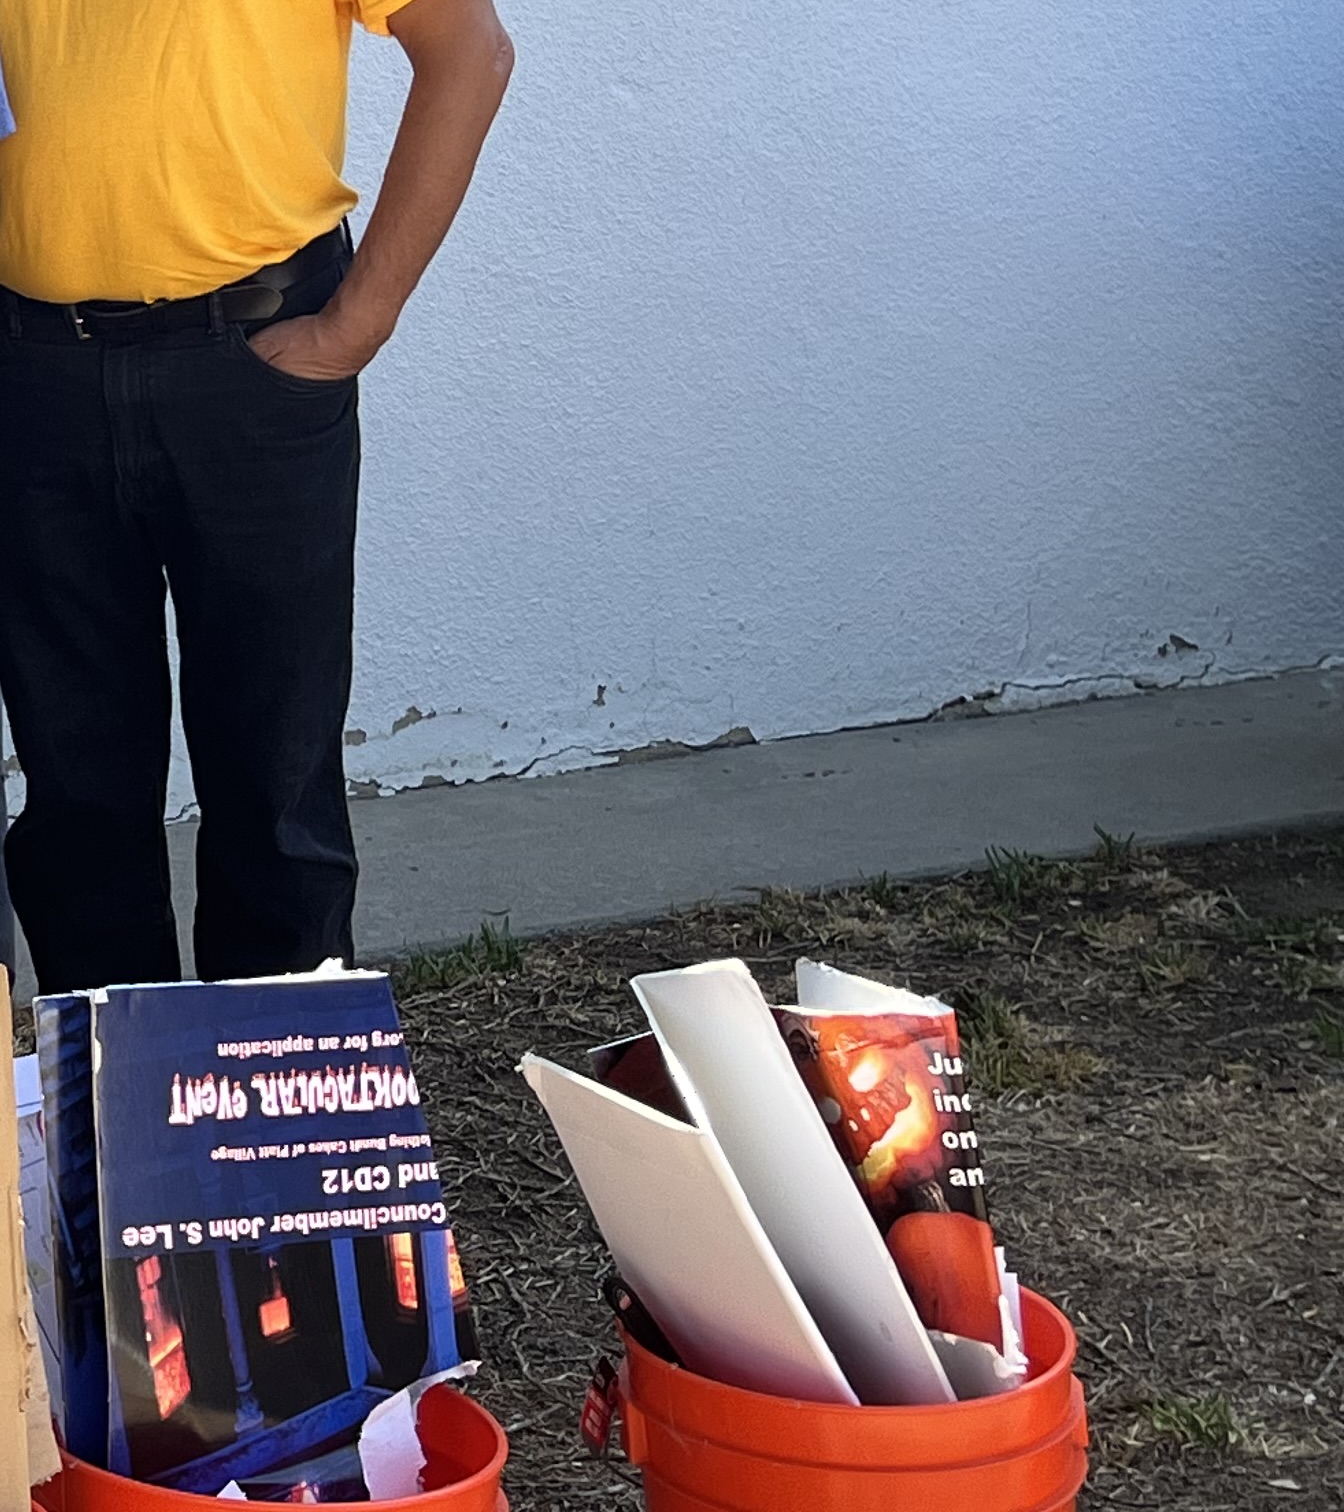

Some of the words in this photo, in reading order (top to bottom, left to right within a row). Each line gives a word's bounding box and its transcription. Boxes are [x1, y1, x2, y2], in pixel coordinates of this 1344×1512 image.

[217, 1034, 315, 1059] application
[318, 1035, 341, 1051] an
[343, 1034, 369, 1053] for
[292, 1143, 306, 1158] of
[308, 1140, 347, 1156] Cakes
[942, 1130, 979, 1150] on
[210, 1146, 256, 1162] Village
[322, 1165, 391, 1195] CD12
[948, 1166, 985, 1187] an
[269, 1201, 448, 1234] Councilmember
[121, 1223, 174, 1250] Lee
[179, 1221, 203, 1245] S.
[209, 1217, 265, 1242] John
